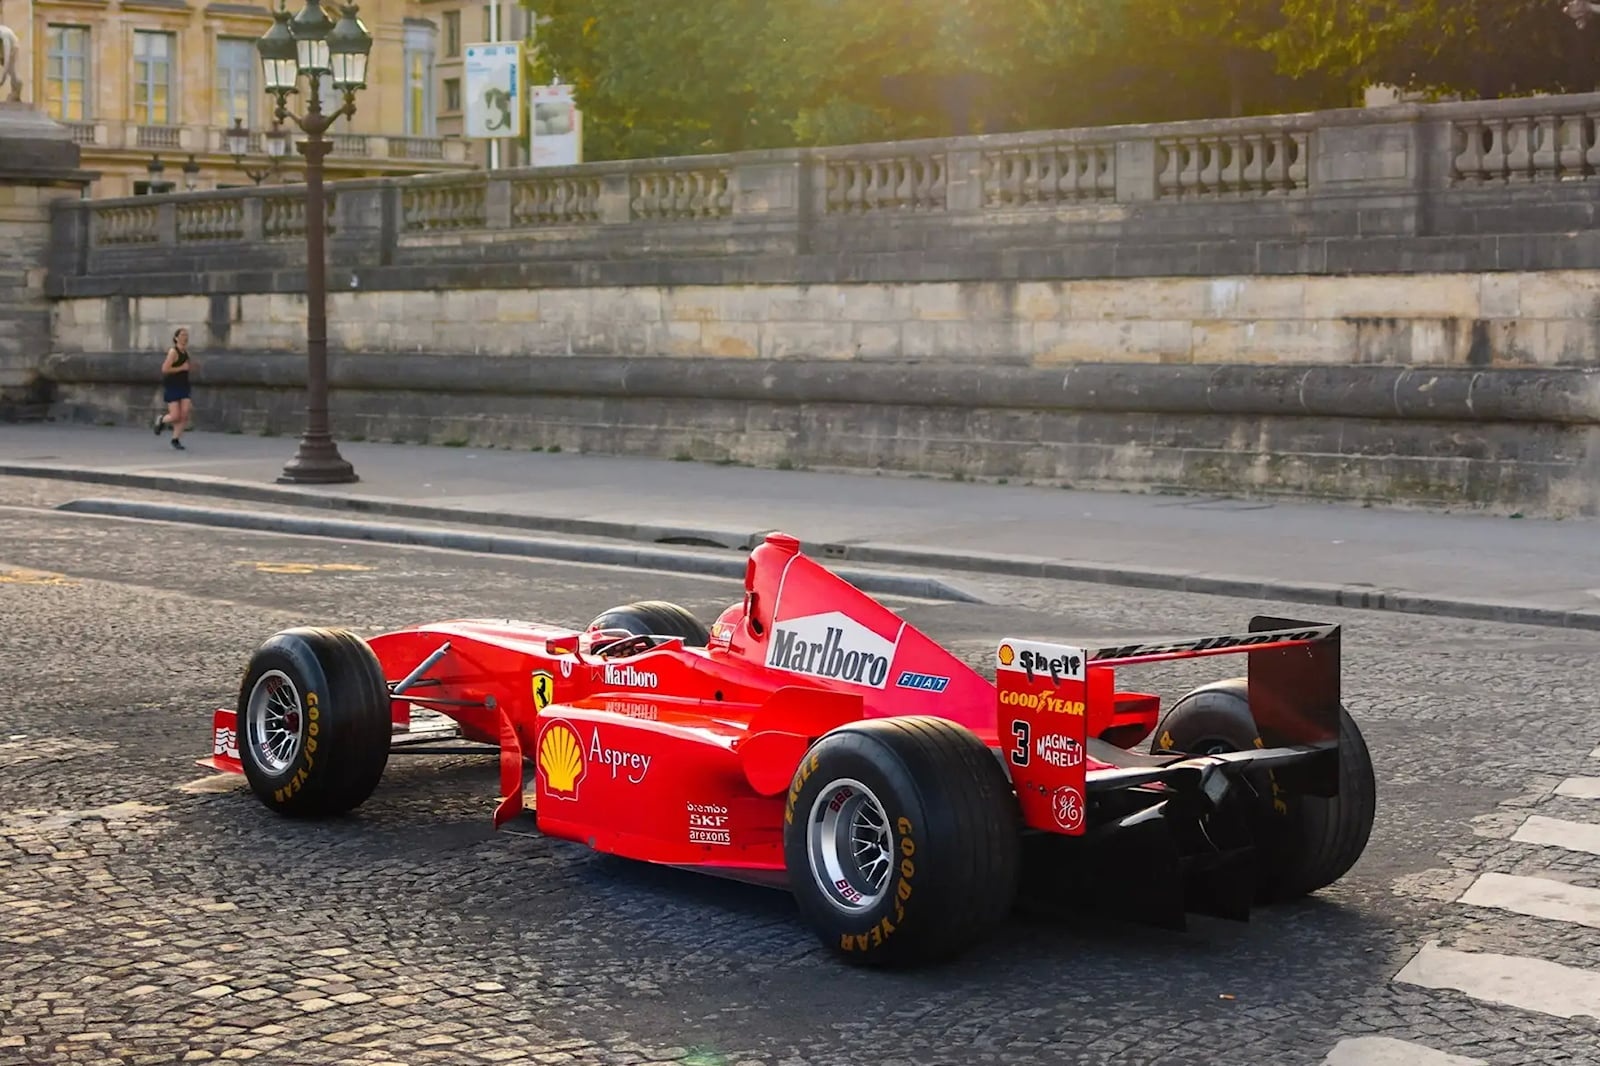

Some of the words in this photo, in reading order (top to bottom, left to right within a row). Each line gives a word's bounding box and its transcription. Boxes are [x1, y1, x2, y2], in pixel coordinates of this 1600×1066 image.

[768, 626, 888, 686] Marlboro
[605, 663, 658, 689] Marlboro
[900, 674, 949, 691] FIAT
[588, 726, 652, 784] Asprey
[1010, 719, 1031, 768] 3
[785, 751, 821, 825] EAGLE
[686, 800, 728, 815] brembo
[689, 814, 729, 827] SKF
[1058, 795, 1078, 821] GE
[689, 829, 731, 842] arexons
[834, 878, 862, 903] BBS
